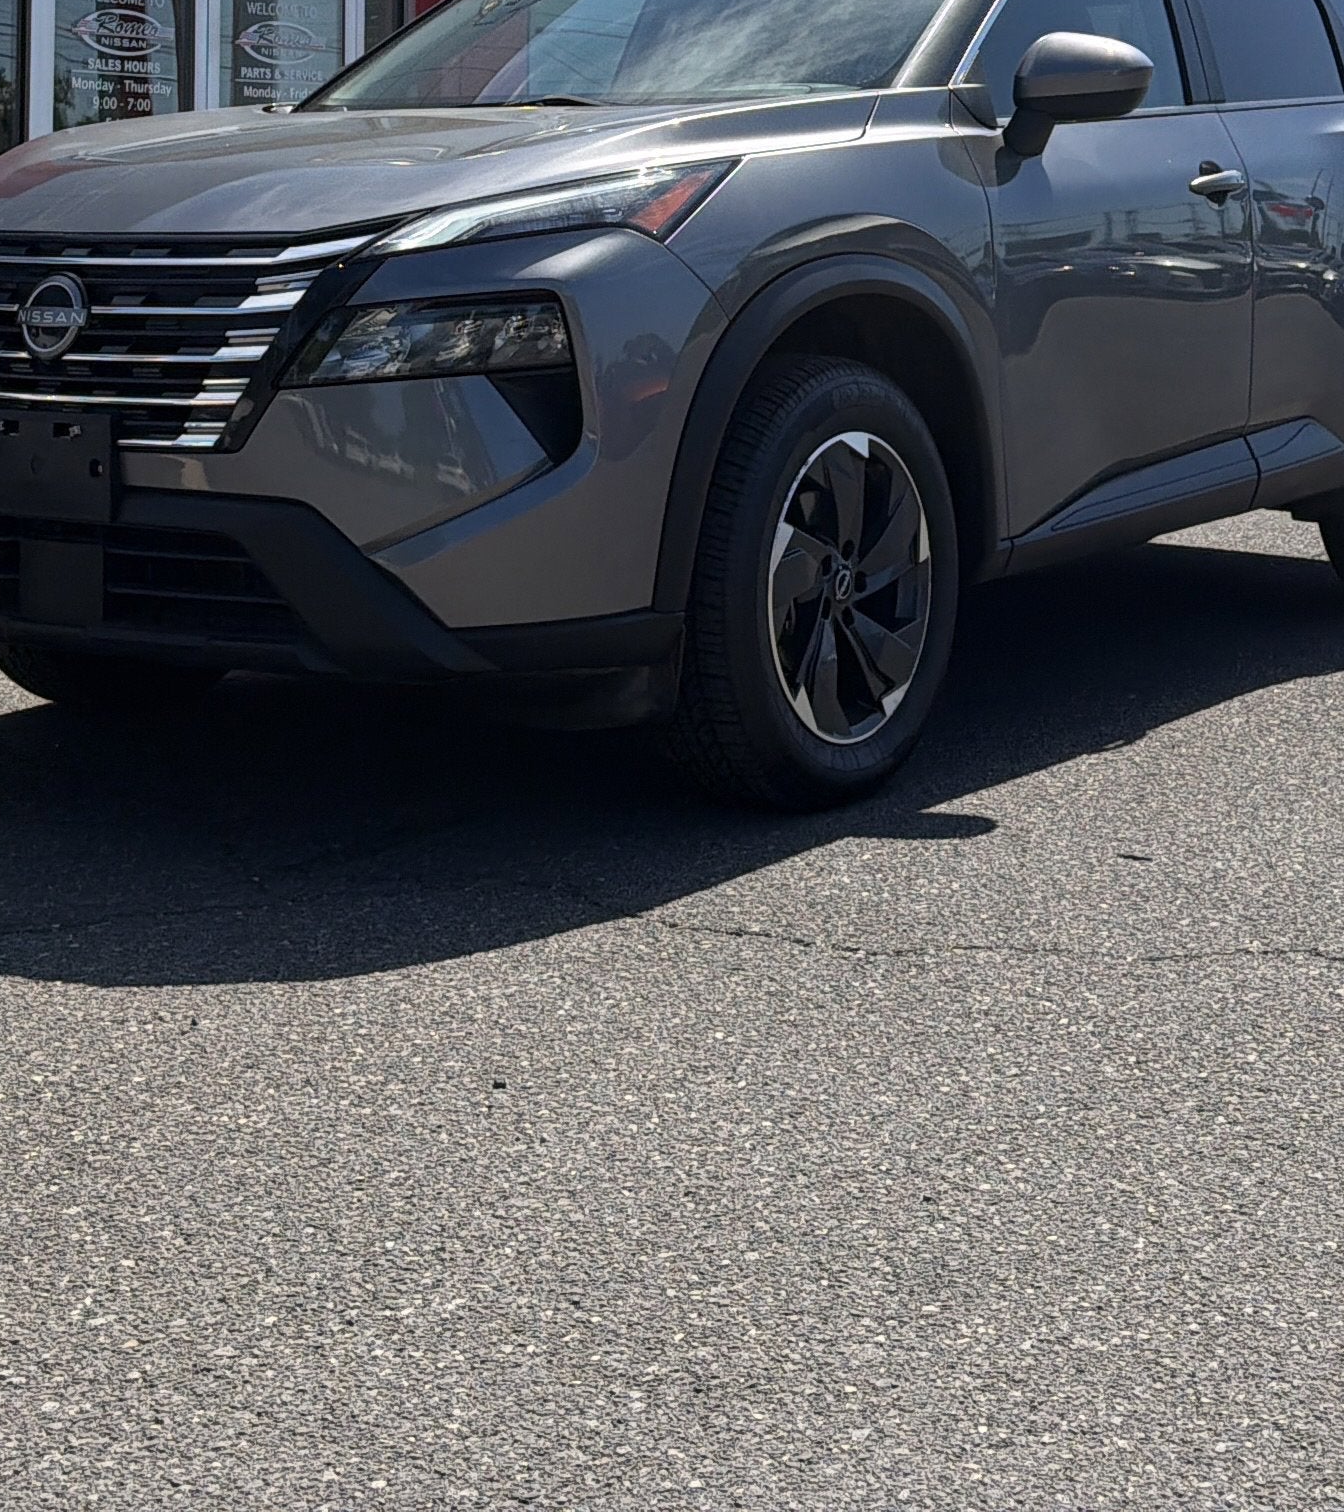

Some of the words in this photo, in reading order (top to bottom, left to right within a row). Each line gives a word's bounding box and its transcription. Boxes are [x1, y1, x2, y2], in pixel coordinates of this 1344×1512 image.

[95, 11, 160, 37] Romeo
[101, 37, 147, 49] NISSAN
[87, 57, 122, 71] SALES
[124, 60, 161, 74] HOURS
[240, 66, 272, 80] PARTS
[274, 68, 281, 80] &
[283, 69, 323, 81] SERVICE
[71, 77, 115, 94] Monday
[124, 79, 173, 97] Thursday
[243, 85, 282, 100] Monday
[290, 87, 313, 100] Frid
[93, 96, 118, 110] 9:00
[127, 97, 151, 112] 7:00
[17, 310, 85, 323] NISSAN
